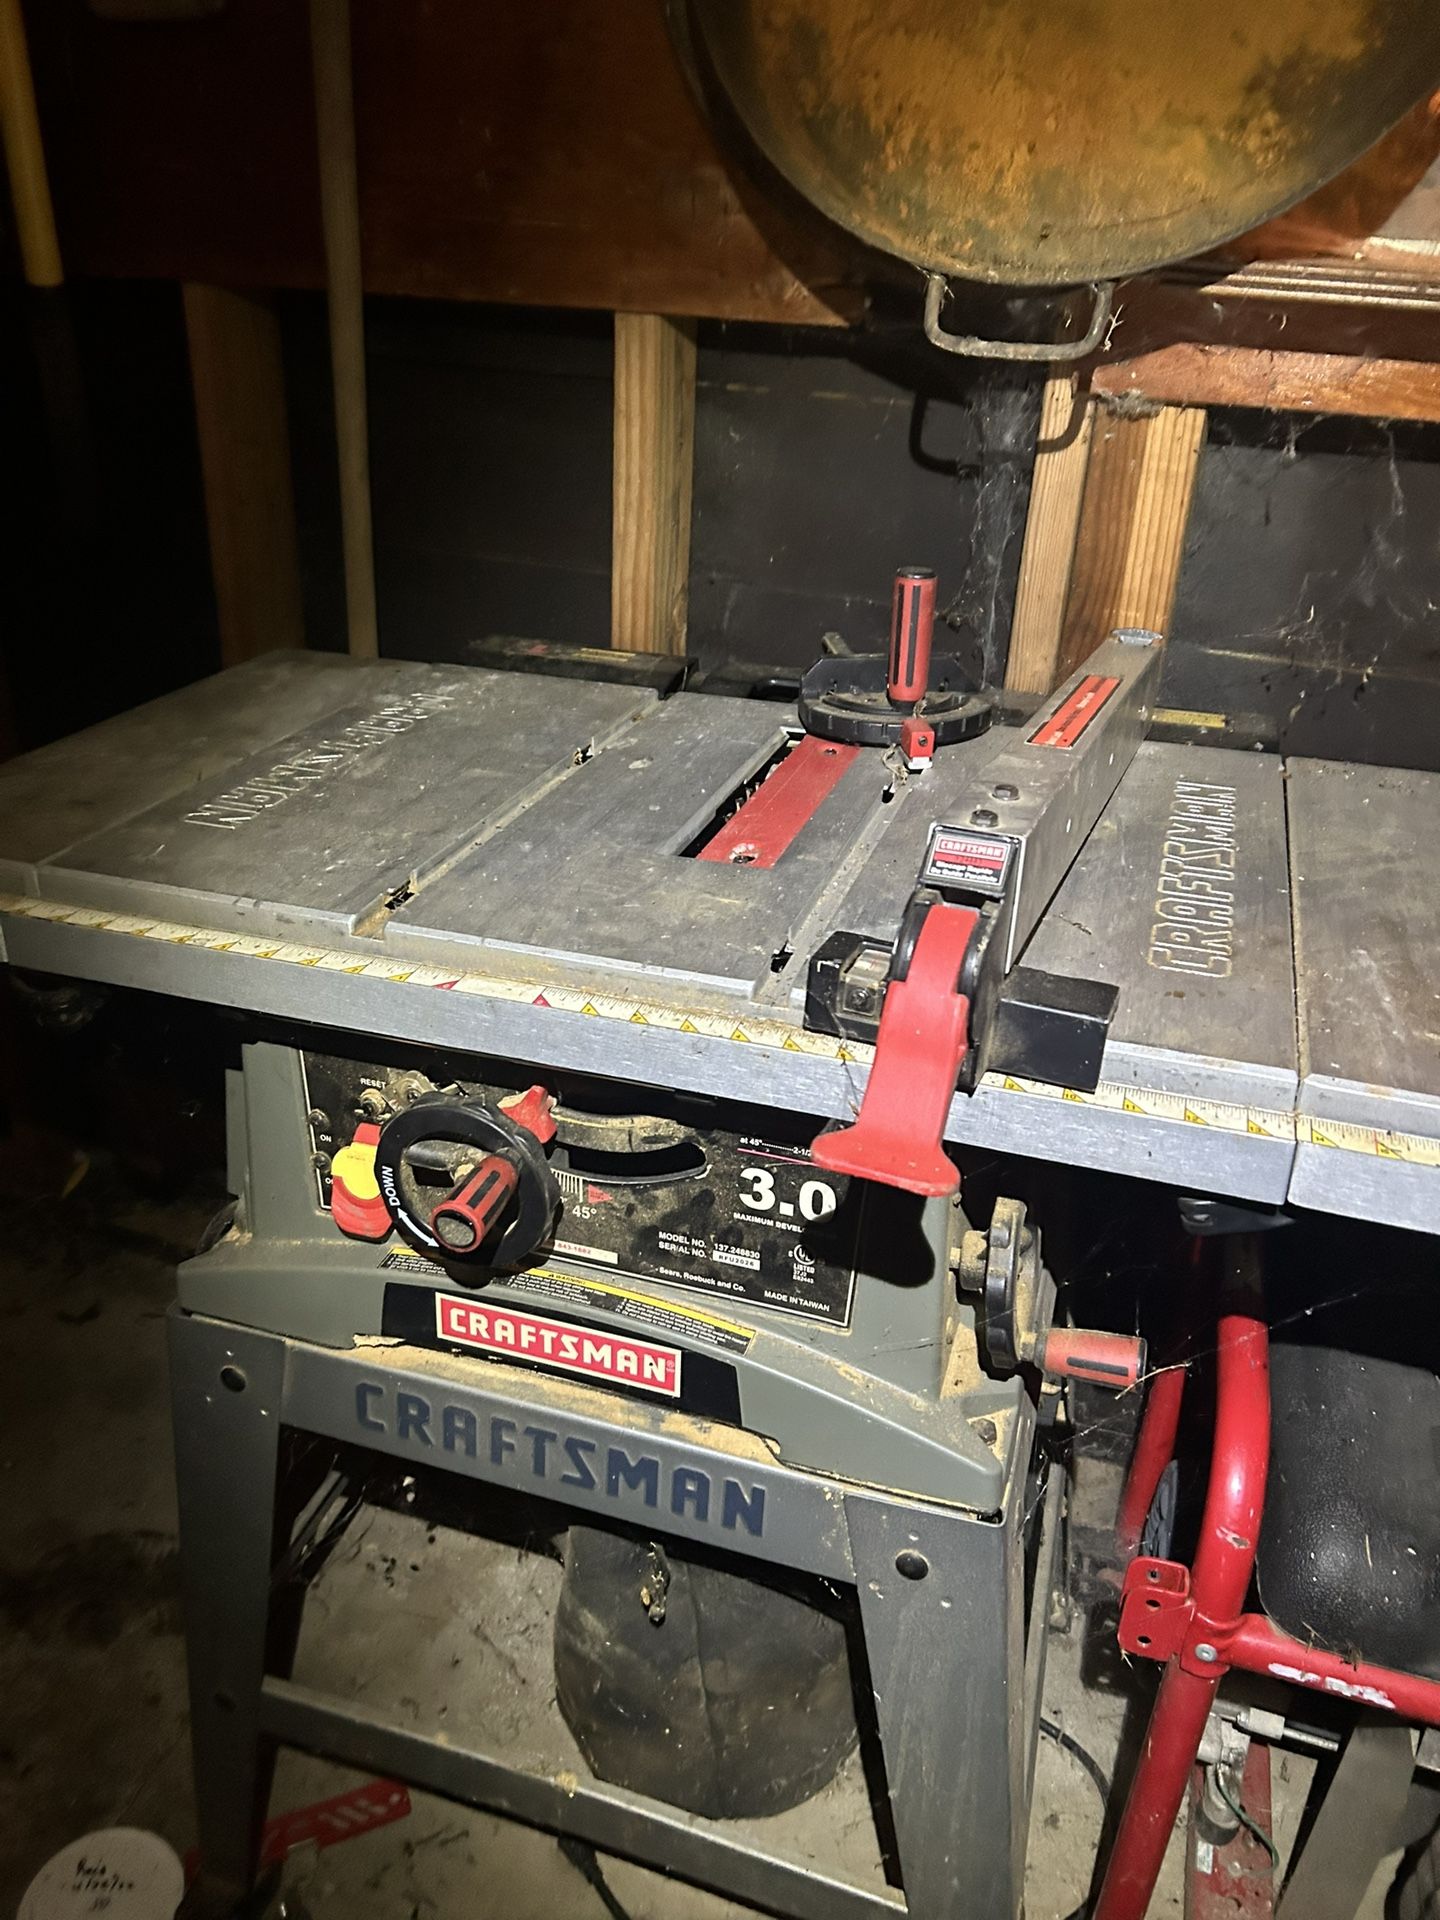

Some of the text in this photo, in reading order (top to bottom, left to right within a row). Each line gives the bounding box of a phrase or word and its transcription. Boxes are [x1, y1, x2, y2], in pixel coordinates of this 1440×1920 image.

[940, 840, 1003, 857] CRAFTSMAN
[1147, 780, 1237, 979] CRAFTSMAN
[360, 1077, 386, 1089] RESET
[319, 1134, 332, 1142] ON
[381, 1165, 401, 1207] DOWN
[738, 1167, 837, 1223] 3.0
[572, 1205, 597, 1220] 45°
[733, 1212, 774, 1227] MAXIMUM
[658, 1231, 690, 1245] MODEL
[691, 1238, 707, 1249] NO.
[658, 1241, 690, 1255] SERIAL
[691, 1248, 707, 1259] NO.
[793, 1263, 815, 1274] LISTED
[659, 1267, 746, 1293] Sears, Roebuck and Co.
[764, 1290, 830, 1312] MADE IN TAIWAN
[449, 1308, 667, 1384] CRAFTSMAN
[355, 1381, 766, 1538] CRAFTSMAN
